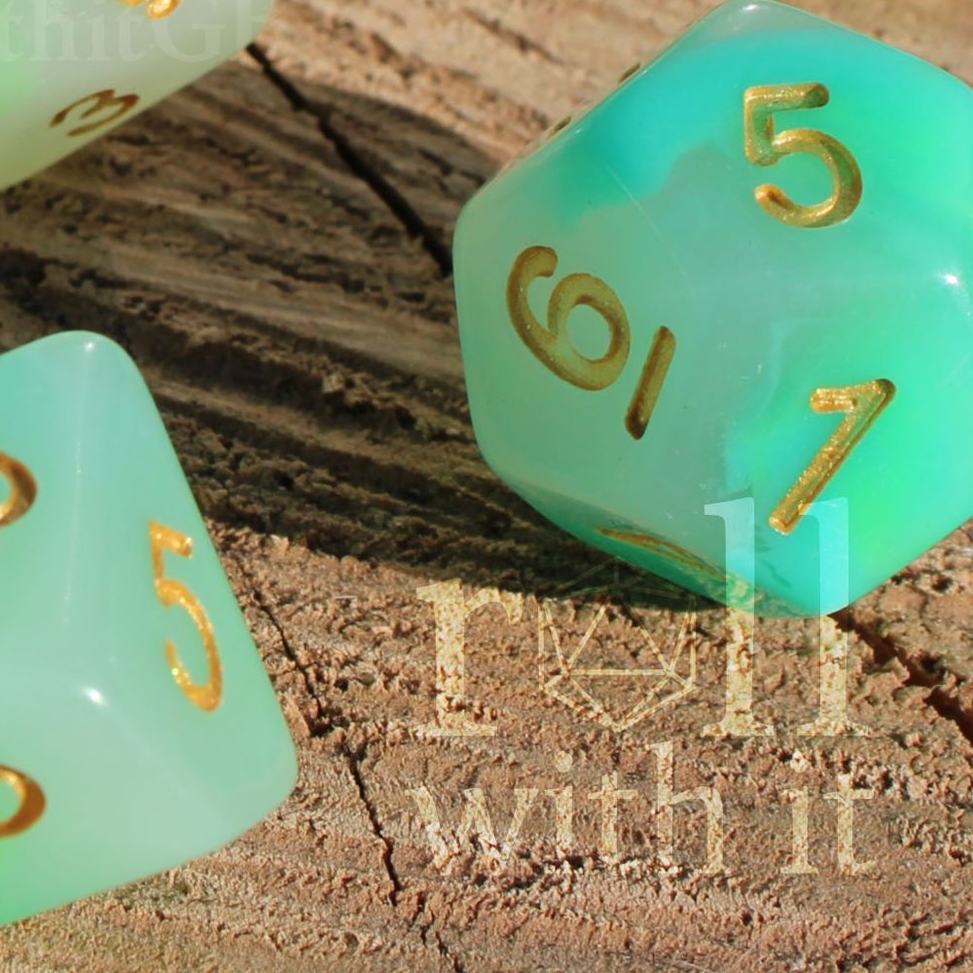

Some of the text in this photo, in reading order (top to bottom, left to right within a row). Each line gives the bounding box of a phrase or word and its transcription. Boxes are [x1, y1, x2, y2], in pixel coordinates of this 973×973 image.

[49, 89, 140, 137] 3
[743, 82, 863, 229] 5
[149, 520, 222, 712] 5
